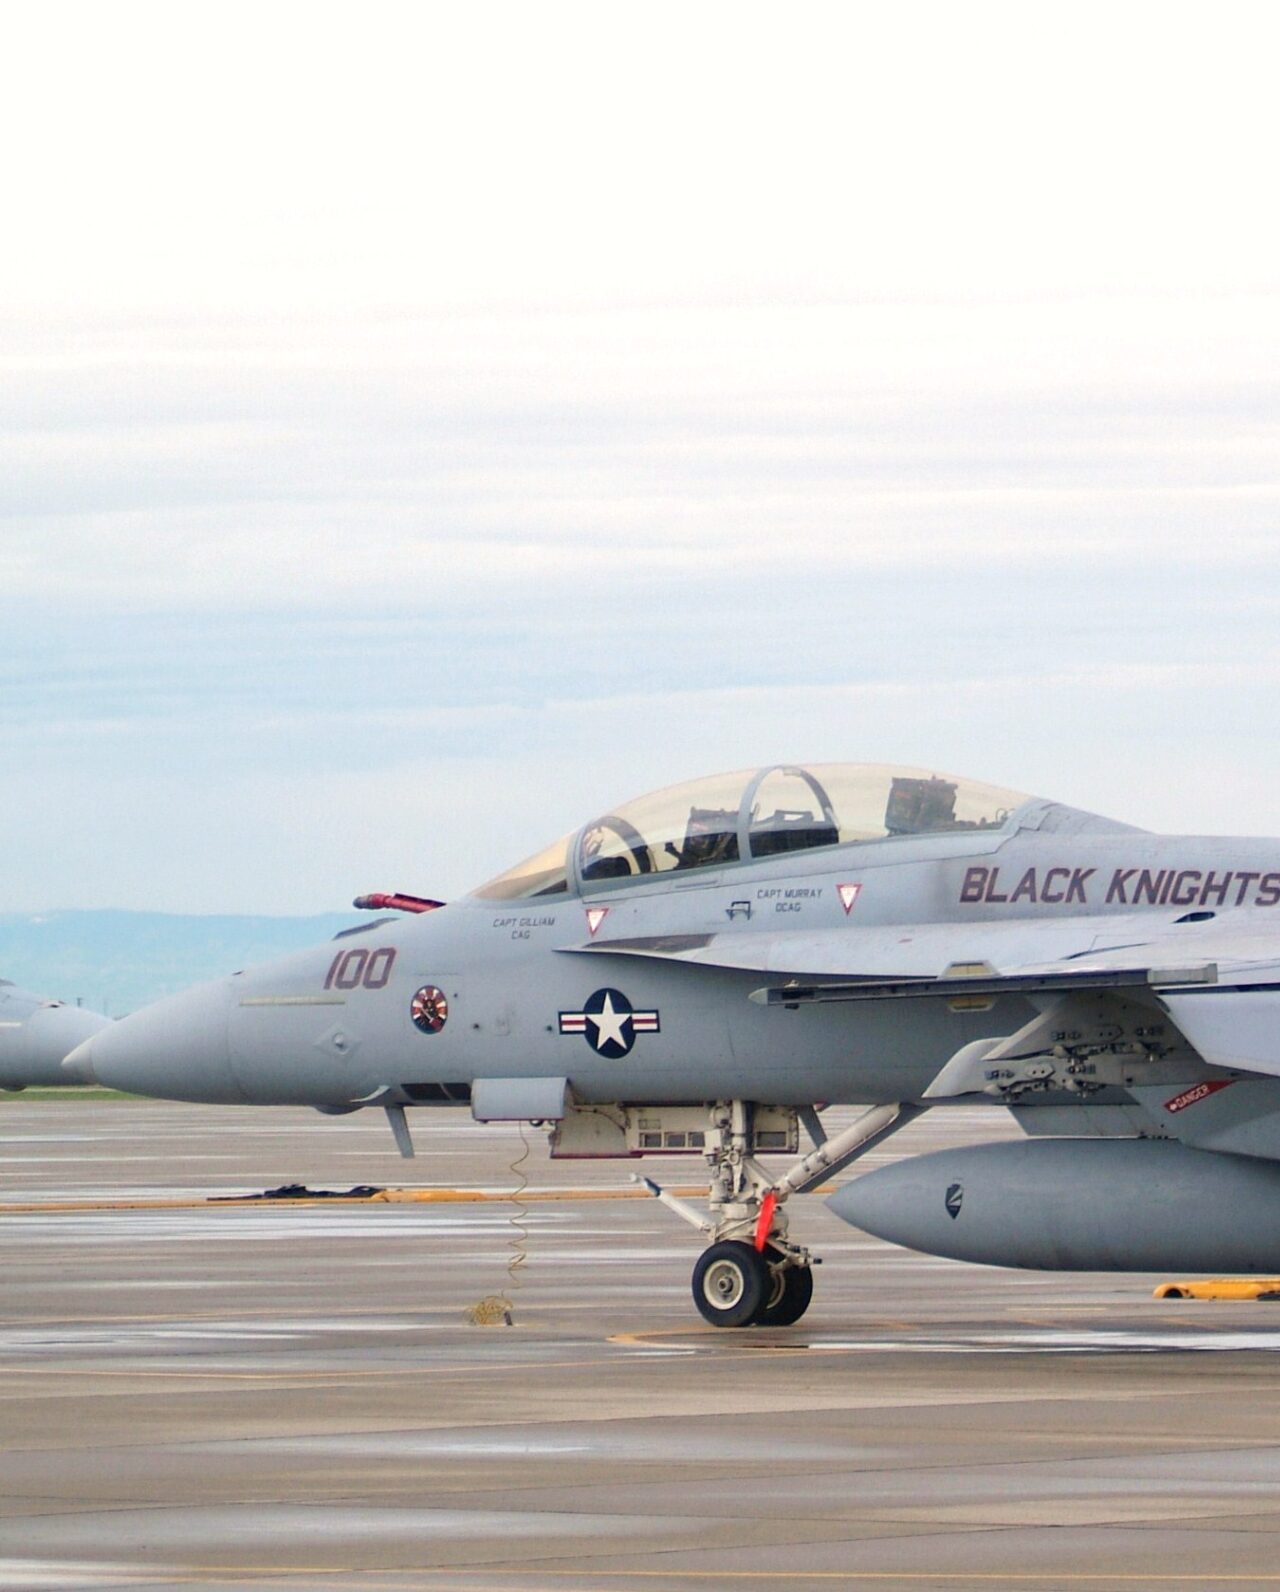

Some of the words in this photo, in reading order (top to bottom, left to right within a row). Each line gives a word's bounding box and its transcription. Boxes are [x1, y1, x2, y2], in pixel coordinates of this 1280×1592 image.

[959, 867, 1097, 903] BLACK
[757, 889, 781, 899] CAPT
[785, 889, 822, 898] MURRAY
[493, 919, 516, 927] CAPT
[511, 931, 531, 939] CAG
[323, 947, 397, 990] 100
[1176, 1084, 1210, 1108] DANGER
